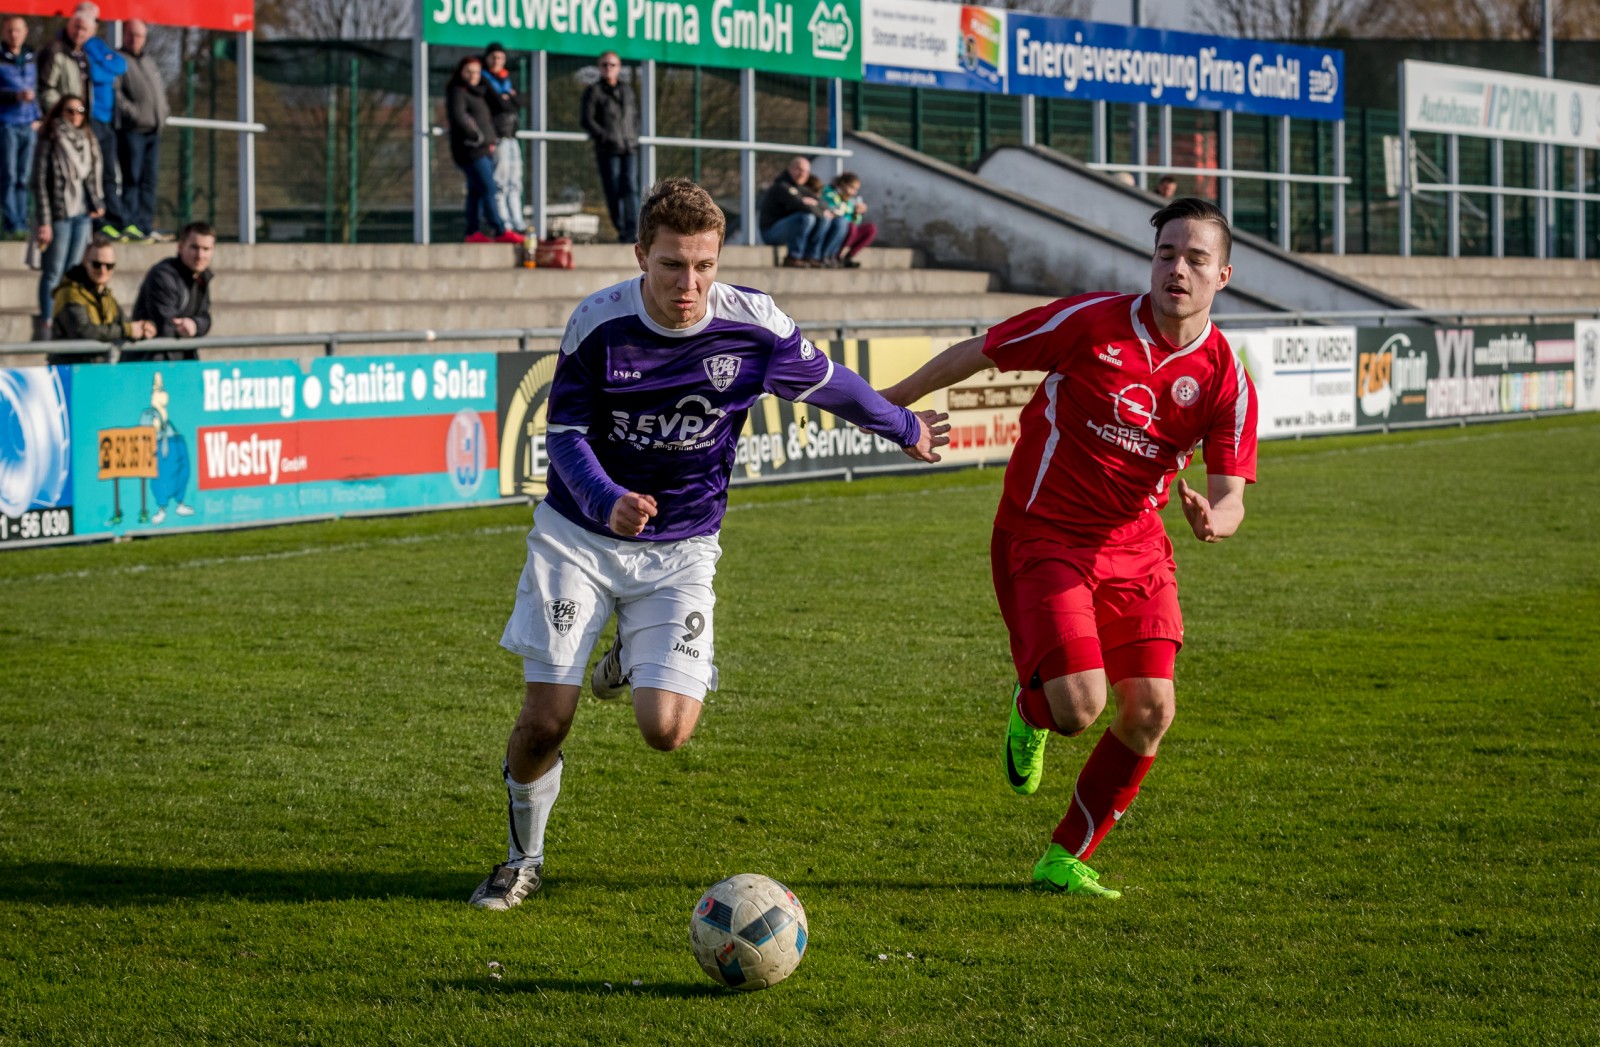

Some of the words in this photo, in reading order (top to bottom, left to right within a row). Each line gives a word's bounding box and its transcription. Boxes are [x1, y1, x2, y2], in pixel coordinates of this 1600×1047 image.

[627, 0, 700, 45] Pirna
[711, 0, 793, 54] GmbH
[1016, 28, 1198, 101] Energieversorgung
[1199, 46, 1246, 95] Pirna
[1247, 53, 1301, 101] GmbH
[1418, 94, 1481, 128] Autohaus
[1496, 85, 1557, 135] PIRNA
[1098, 352, 1123, 367] erima
[203, 368, 295, 418] Heizung
[329, 362, 406, 405] Sanitär
[433, 359, 487, 399] Solar
[636, 412, 705, 441] EVP
[735, 432, 784, 472] agen
[786, 421, 804, 461] &
[805, 420, 873, 459] Service
[1103, 423, 1150, 442] OPEL
[204, 431, 282, 485] Wostry
[280, 455, 308, 473] GmbH
[20, 510, 41, 539] 56
[41, 508, 70, 537] 030
[682, 611, 706, 643] 9
[672, 642, 700, 659] JAKO
